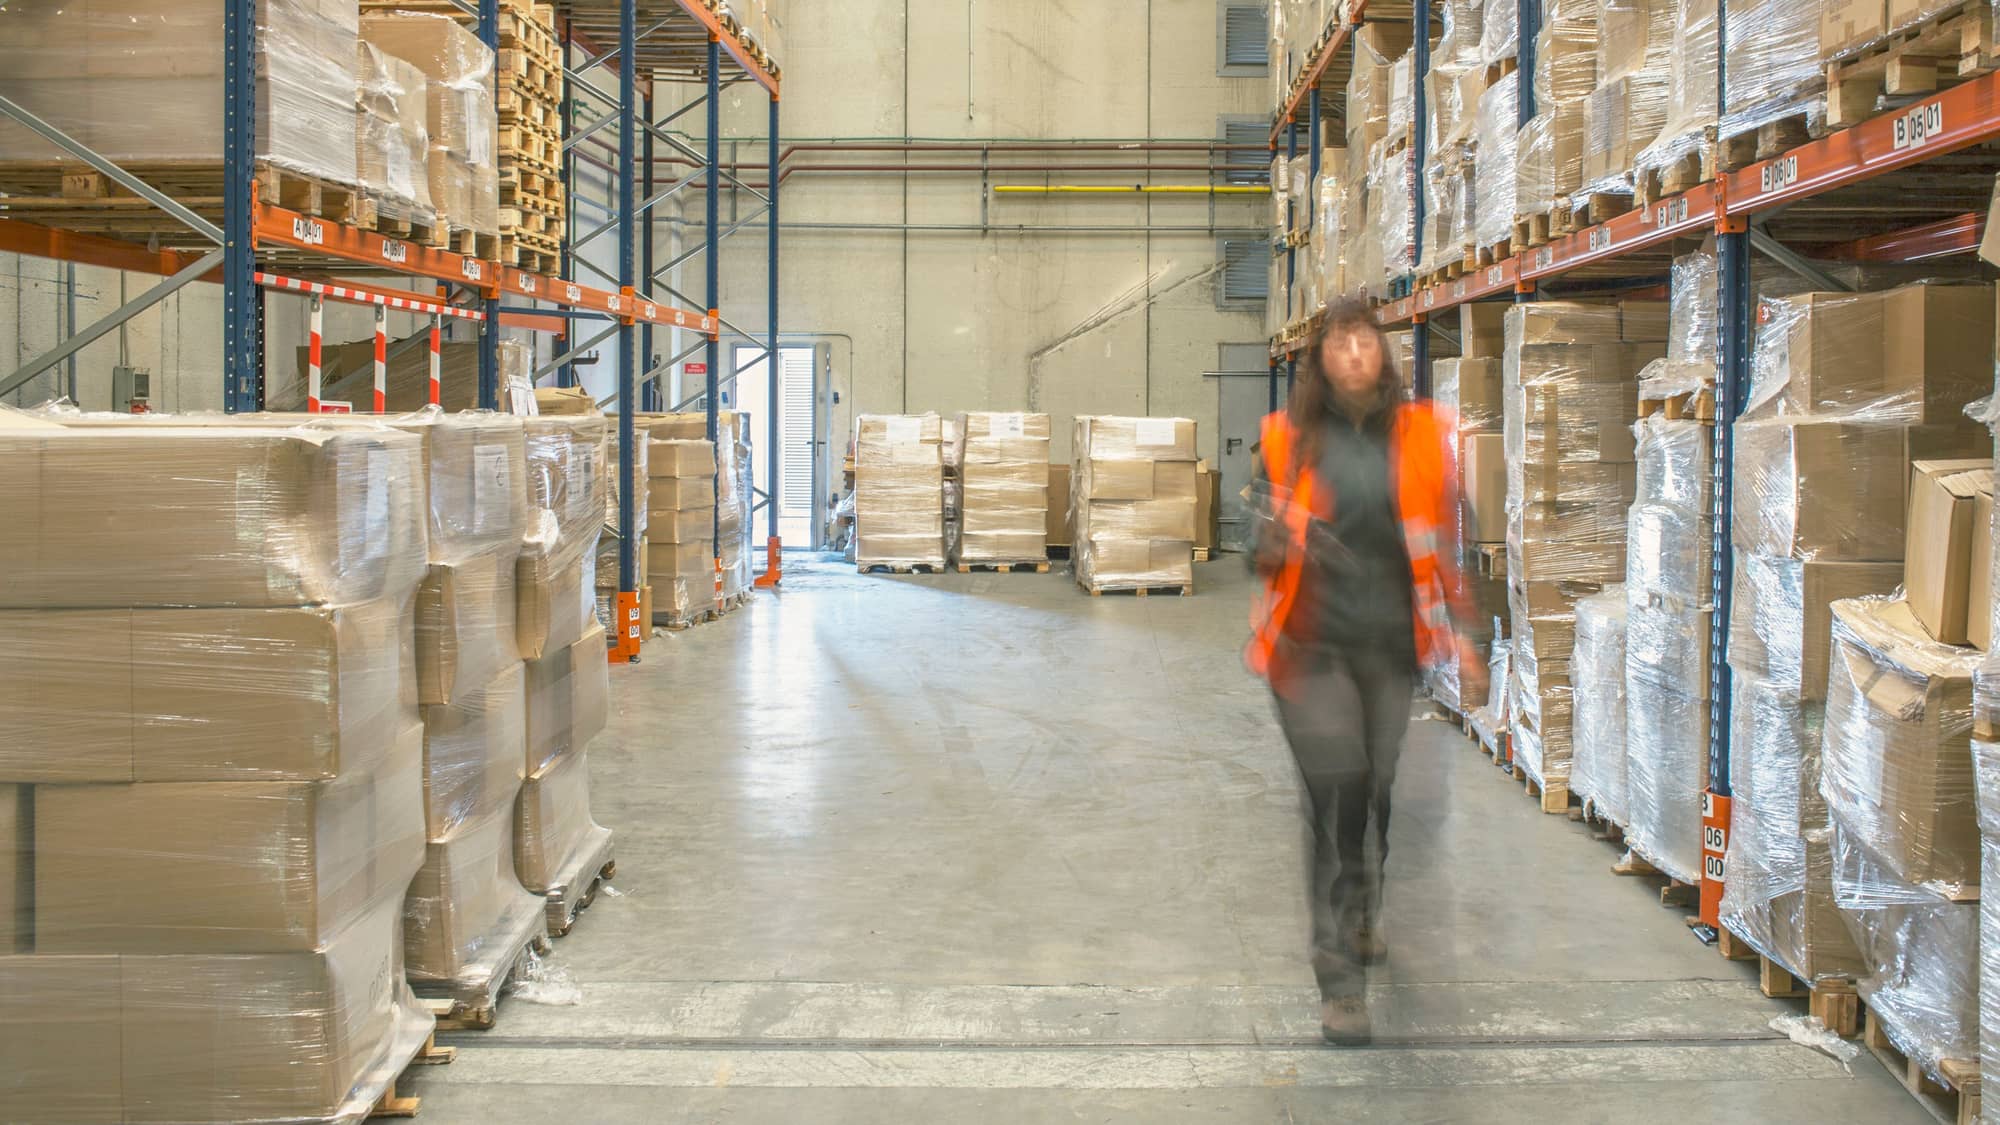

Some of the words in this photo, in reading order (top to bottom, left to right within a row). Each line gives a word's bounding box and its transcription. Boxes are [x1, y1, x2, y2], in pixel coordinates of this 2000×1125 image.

[1896, 118, 1905, 142] B
[1911, 114, 1923, 140] 05
[1927, 103, 1939, 129] 01
[1764, 166, 1771, 186] B
[1774, 162, 1784, 184] 06
[1787, 157, 1796, 178] 01
[295, 219, 301, 235] A
[1706, 827, 1722, 847] 06
[1707, 856, 1724, 877] 00
